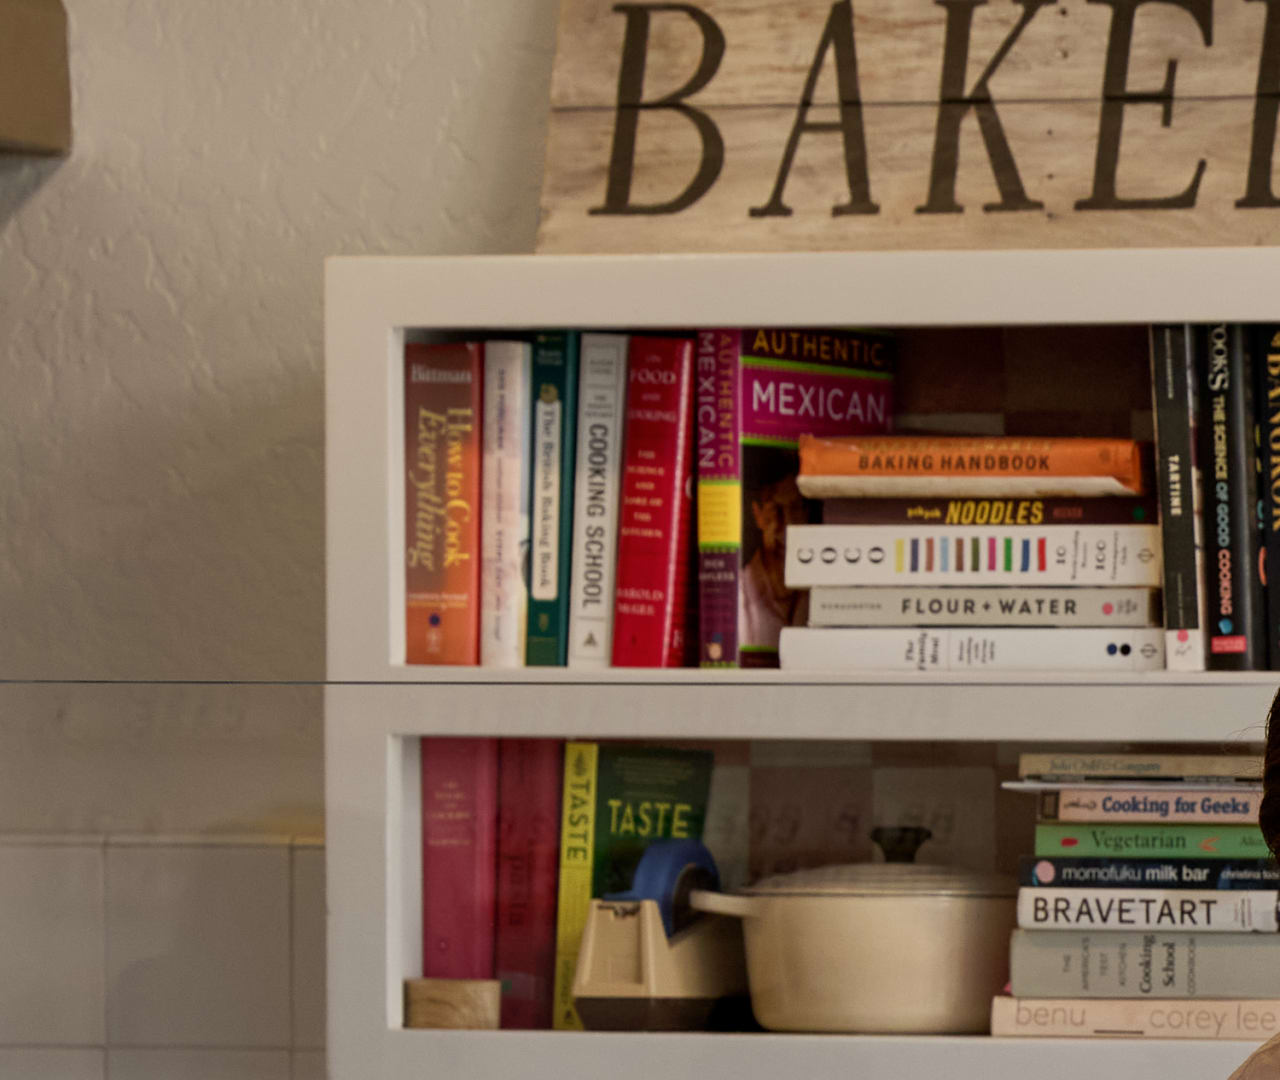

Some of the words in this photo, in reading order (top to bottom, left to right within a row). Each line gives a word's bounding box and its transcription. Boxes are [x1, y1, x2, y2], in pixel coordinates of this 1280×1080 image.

[752, 329, 886, 366] AUTHENTIC
[1208, 323, 1230, 391] OOK'S
[698, 331, 716, 468] MEXICAN
[718, 333, 734, 467] AUTHENTIC
[752, 378, 886, 425] MEXICAN
[1212, 396, 1226, 421] THE
[446, 407, 473, 470] How
[1213, 423, 1229, 480] SCIENCE
[446, 472, 468, 495] to
[586, 424, 610, 517] COOKING
[858, 454, 934, 471] BAKING
[940, 454, 1050, 471] HANDBOOK
[1167, 455, 1182, 516] TARTINE
[408, 406, 447, 571] Everything
[1215, 482, 1229, 502] OF
[443, 497, 472, 567] Cook
[945, 500, 1044, 525] NOODLES
[1216, 504, 1230, 547] GOOD
[582, 524, 606, 608] SCHOOL
[1217, 549, 1233, 615] COOKING
[901, 598, 976, 616] FLOUR
[1000, 598, 1078, 616] WATER
[566, 780, 590, 862] TASTE
[607, 799, 692, 839] TASTE
[1101, 796, 1170, 817] Cooking
[1174, 797, 1199, 813] for
[1201, 797, 1250, 815] Geeks
[1091, 830, 1187, 851] Vegetarian
[1061, 866, 1142, 882] momofuku
[1145, 865, 1178, 881] milk
[1182, 865, 1210, 881] bar
[1032, 897, 1218, 925] BRAVETART
[1138, 934, 1156, 994] Cooking
[1162, 942, 1176, 988] School
[1014, 998, 1086, 1028] benu
[1150, 1007, 1226, 1037] corey
[1236, 1003, 1277, 1031] lee
